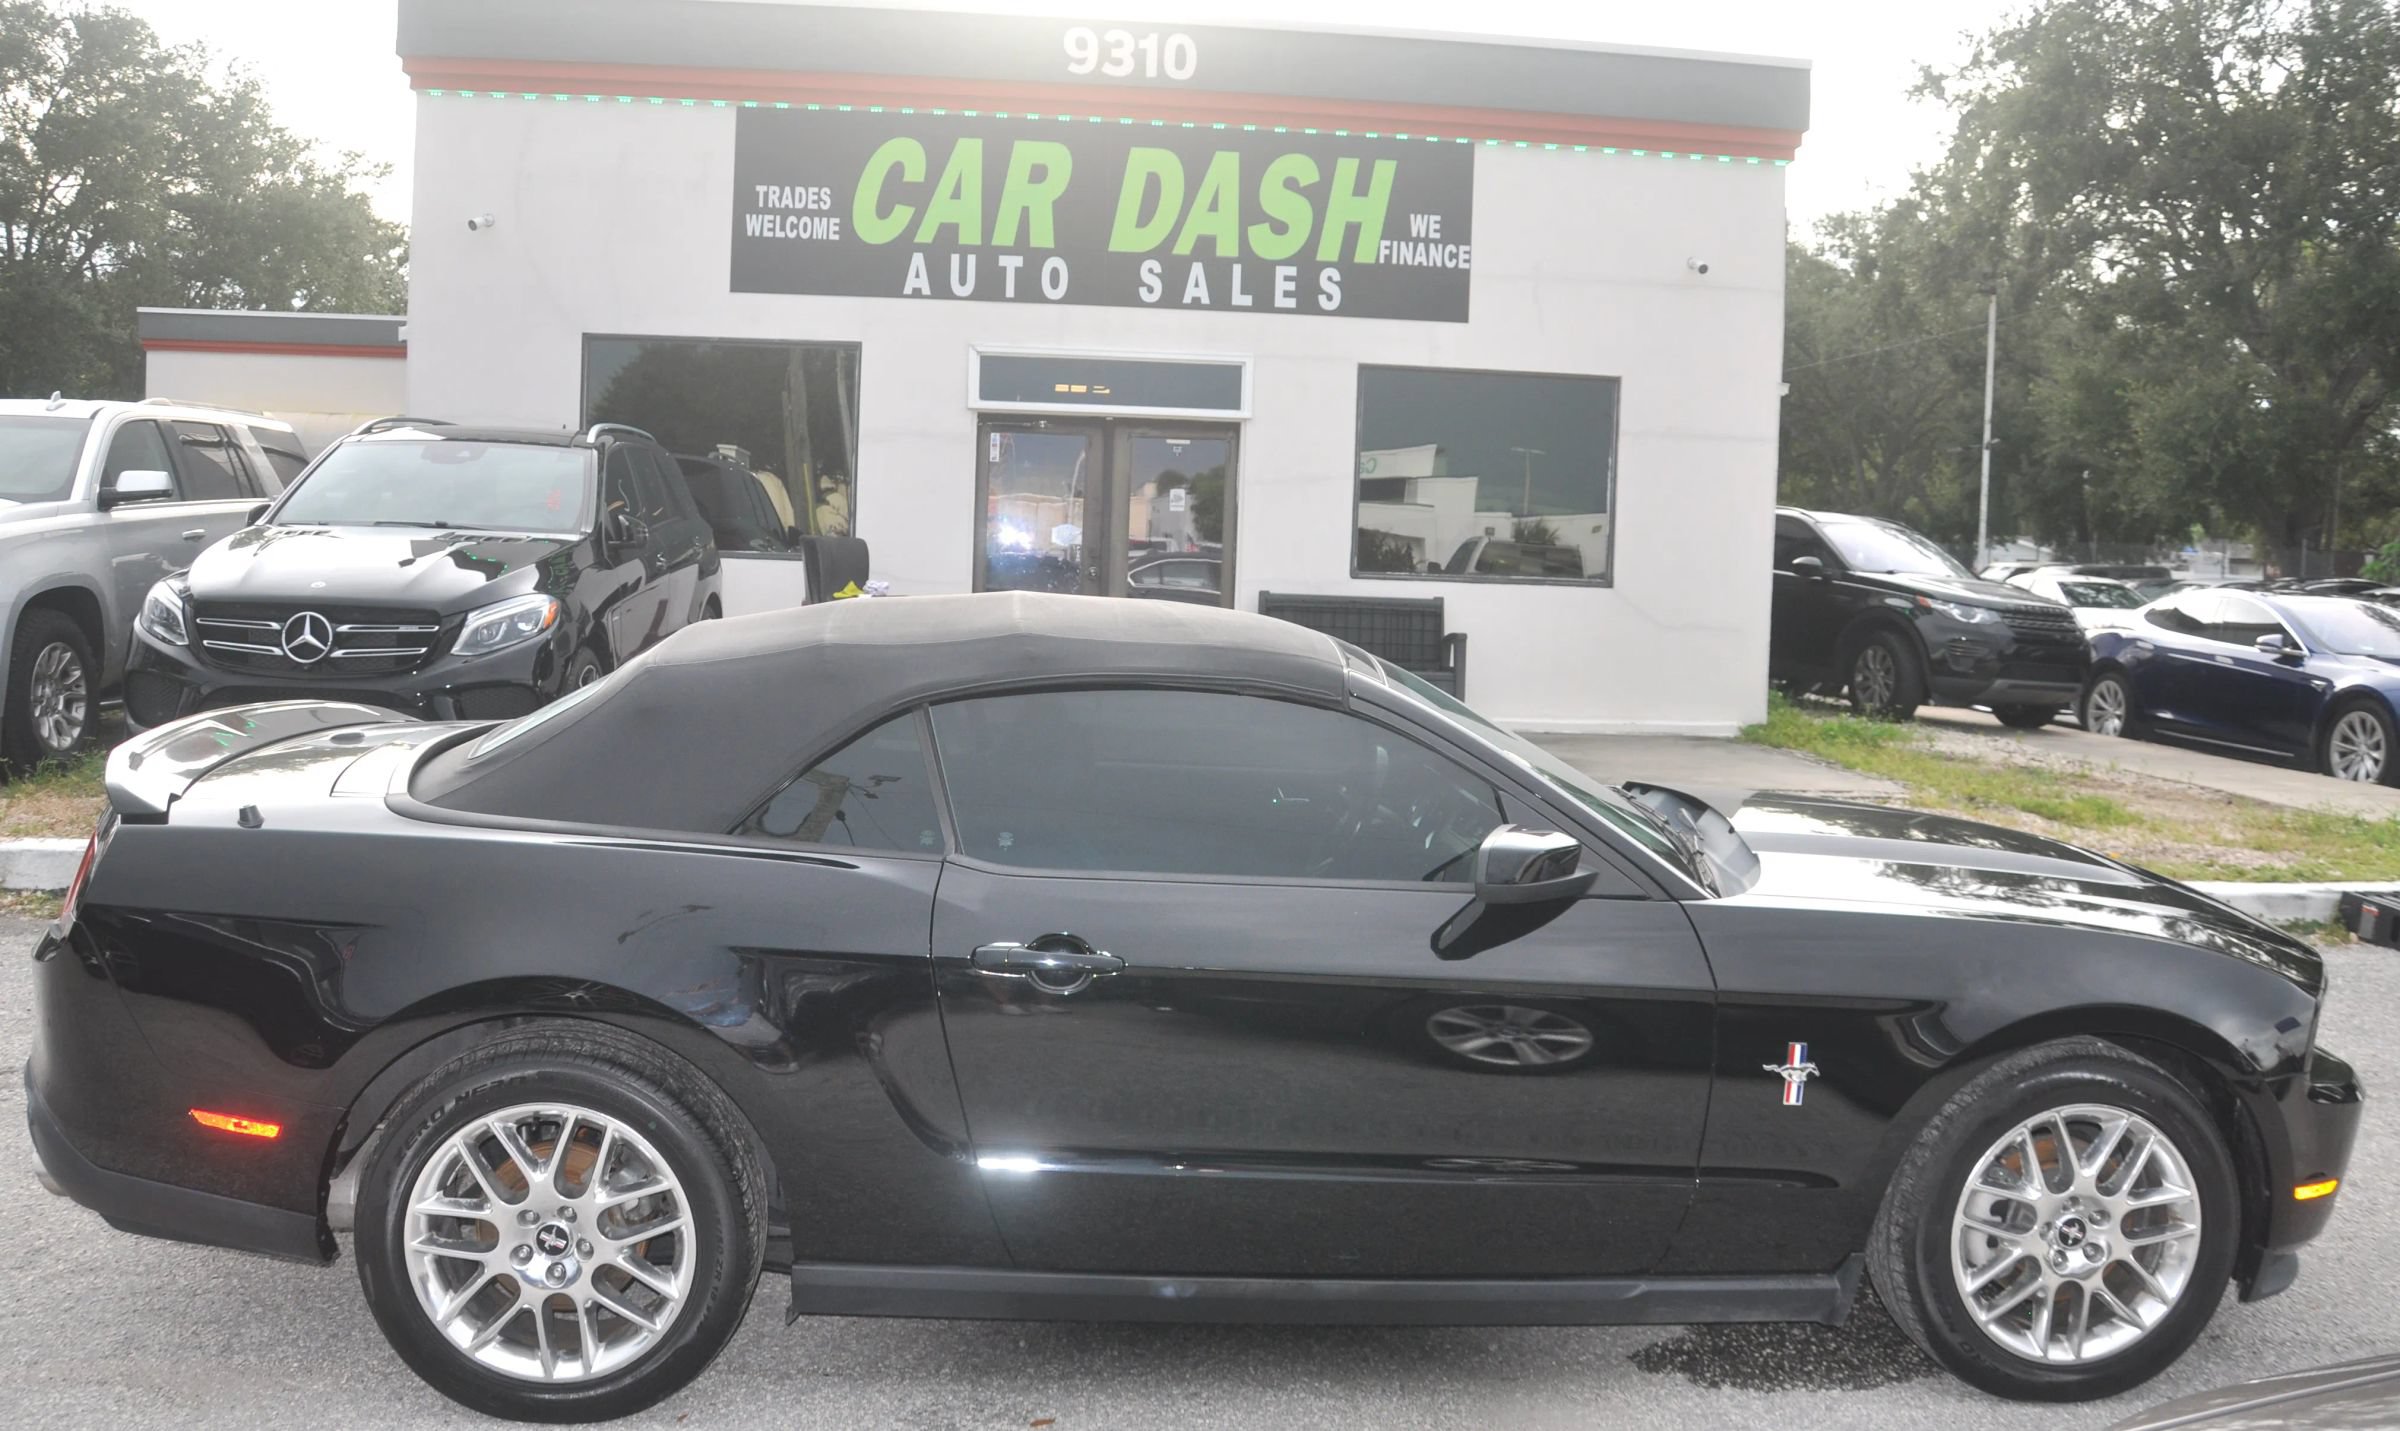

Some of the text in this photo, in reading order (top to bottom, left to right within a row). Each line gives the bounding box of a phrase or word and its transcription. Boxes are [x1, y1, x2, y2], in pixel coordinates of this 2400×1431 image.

[1063, 26, 1197, 80] 9310
[755, 184, 831, 211] TRADES
[853, 137, 1397, 264] CAR DASH
[745, 213, 841, 241] WELCOME
[1409, 213, 1442, 239] WE
[1379, 240, 1472, 270] FINANCE
[902, 252, 1342, 311] AUTO SALES
